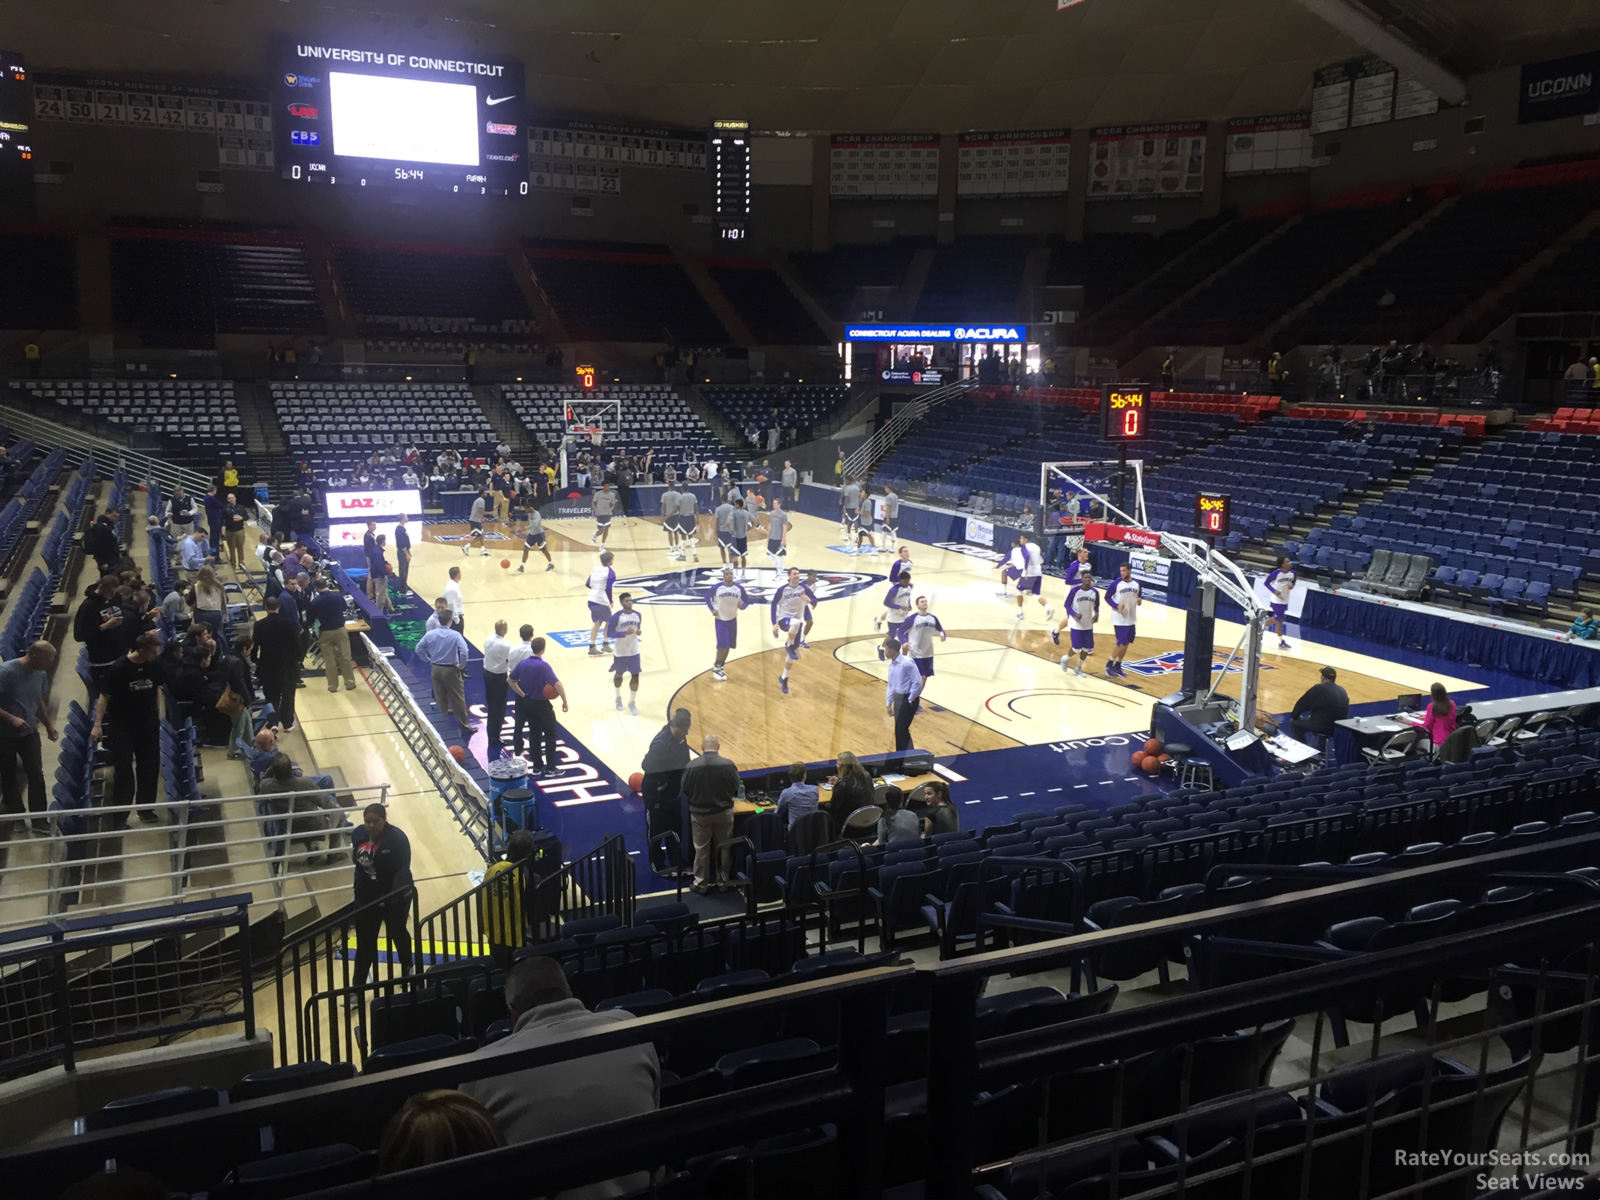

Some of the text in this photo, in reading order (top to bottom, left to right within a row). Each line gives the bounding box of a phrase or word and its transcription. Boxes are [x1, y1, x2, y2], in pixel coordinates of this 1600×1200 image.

[297, 44, 504, 77] UNIVERSITY OF CONNECTICUT
[1528, 73, 1592, 97] UCONN
[38, 101, 60, 114] 24
[70, 103, 90, 117] 50
[104, 106, 120, 119] 21
[133, 108, 151, 122] 52
[162, 111, 182, 124] 42
[1126, 123, 1200, 134] CHAMPIONSHIP
[1230, 118, 1254, 126] NCAA
[291, 130, 318, 141] CBS
[993, 131, 1064, 140] CHAMPIONSHIP
[292, 165, 301, 179] 0
[394, 168, 424, 180] 56:44
[361, 178, 366, 186] 0
[520, 182, 528, 194] 0
[602, 178, 616, 190] 23
[965, 328, 1018, 339] ACURA
[576, 366, 594, 375] 56:44
[584, 374, 592, 387] 0
[1110, 393, 1142, 408] 56:44
[1125, 410, 1138, 436] 0
[340, 498, 394, 509] LAZ FLY
[1211, 513, 1220, 529] 0
[1049, 736, 1130, 752] Court
